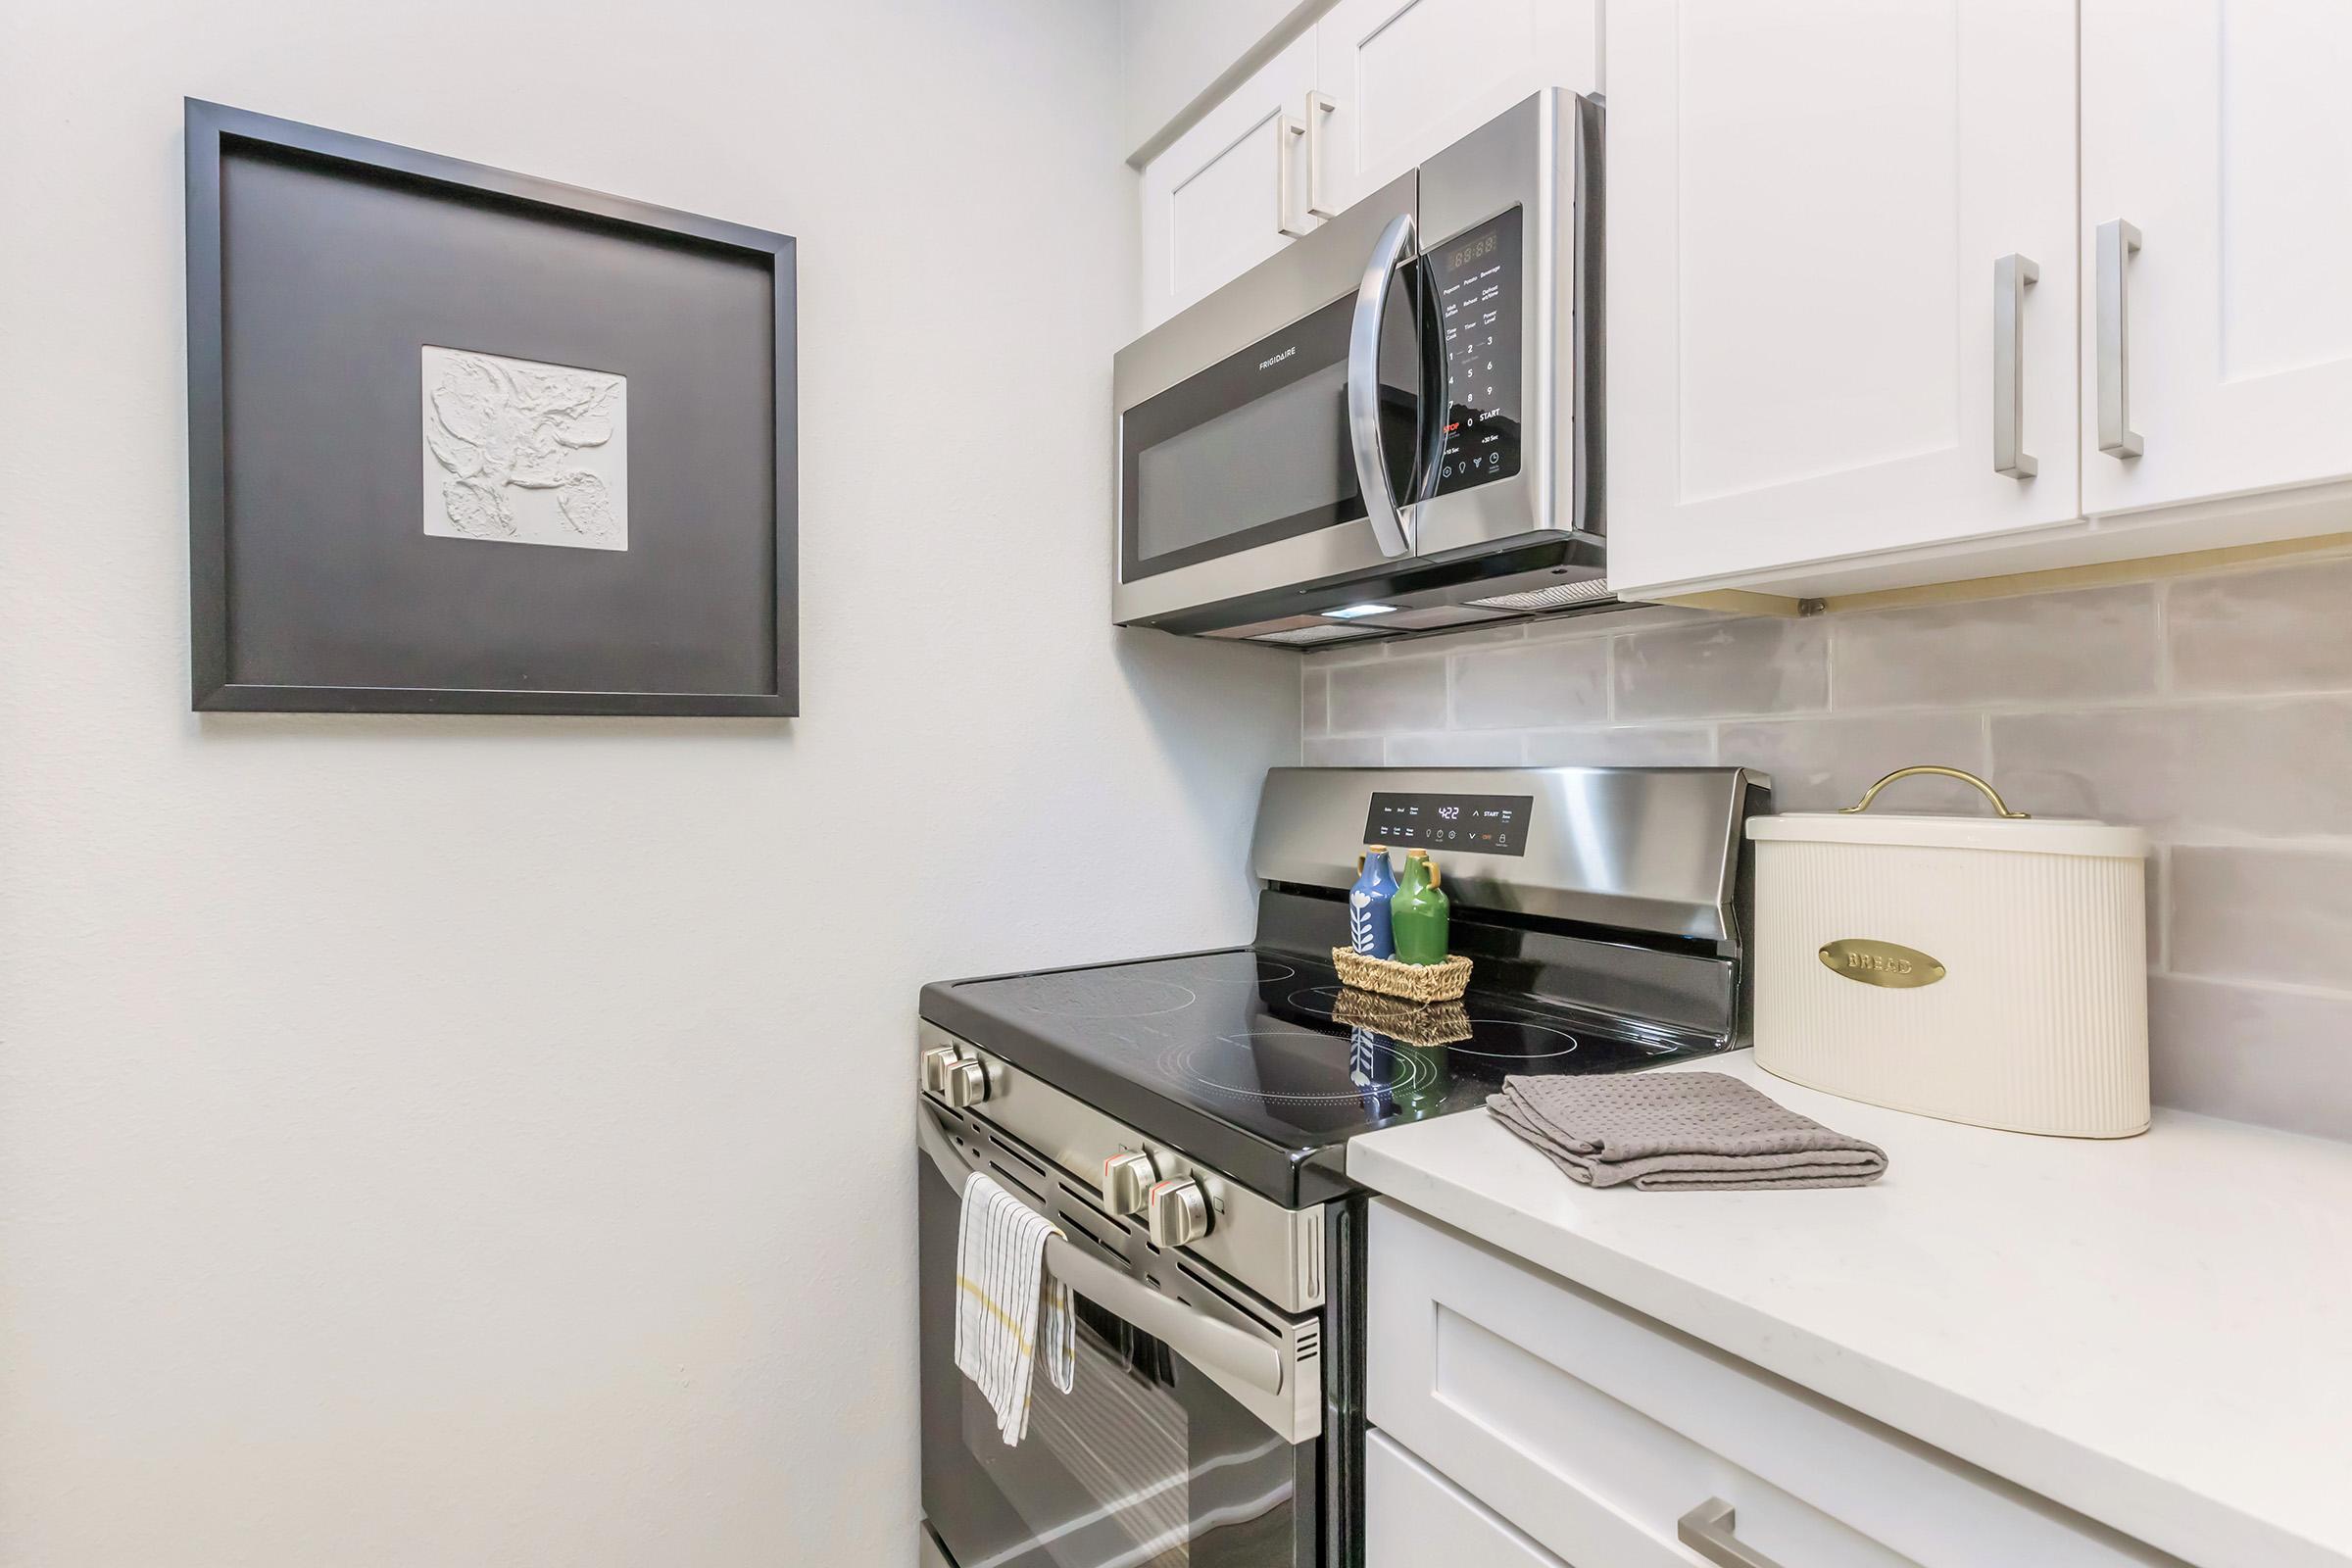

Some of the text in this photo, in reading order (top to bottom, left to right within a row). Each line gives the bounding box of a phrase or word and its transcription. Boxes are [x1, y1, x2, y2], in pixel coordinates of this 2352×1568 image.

[1467, 344, 1473, 353] 2
[1487, 336, 1493, 345] 3
[1259, 346, 1296, 370] FRIGIDAIRE
[1467, 368, 1473, 377] 5
[1487, 361, 1493, 369] 6
[1448, 386, 1493, 409] 7 8 9
[1443, 422, 1459, 433] STOP
[1479, 408, 1500, 421] START
[1438, 807, 1459, 820] 422
[1847, 952, 1913, 974] BREAD
